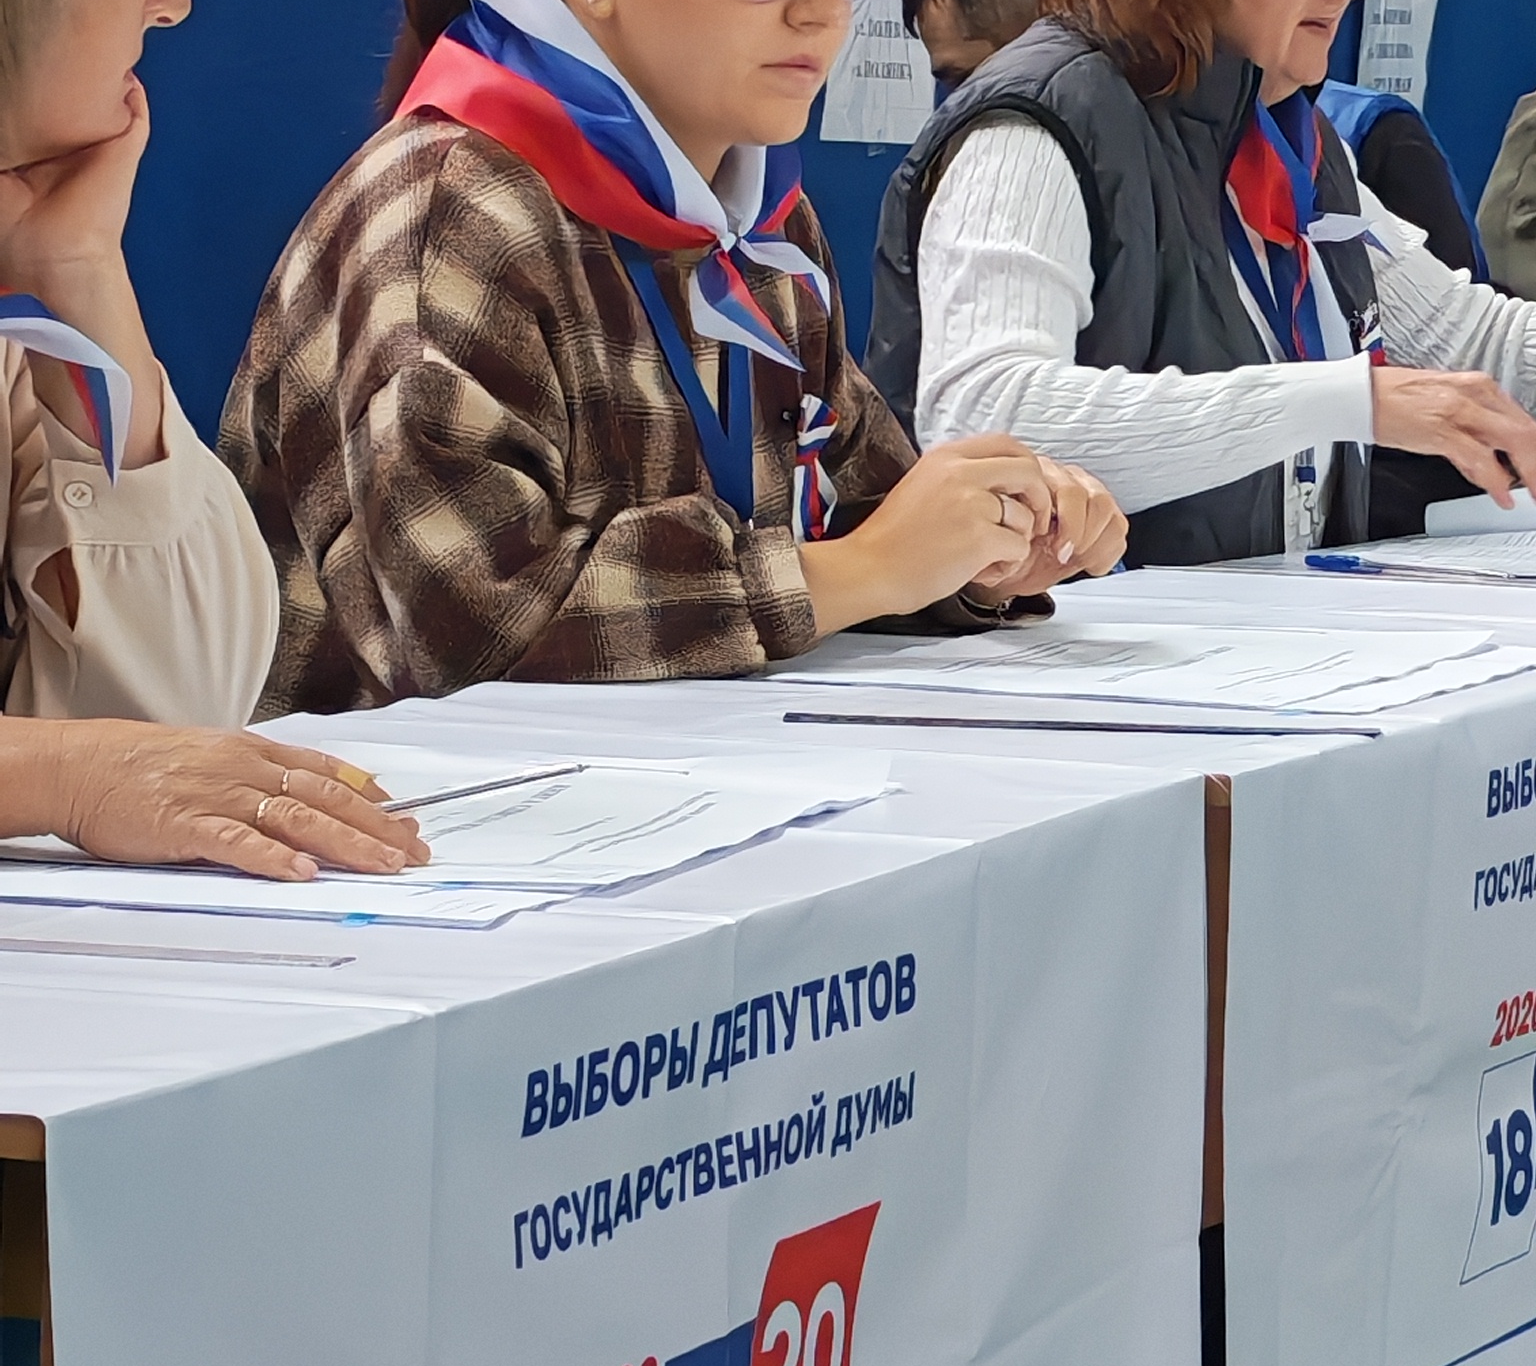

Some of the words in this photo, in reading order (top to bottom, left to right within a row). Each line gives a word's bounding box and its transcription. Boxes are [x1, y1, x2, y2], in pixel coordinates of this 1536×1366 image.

[521, 1022, 699, 1138] ВЫБОРЫ
[702, 953, 916, 1087] ДЕПУТАТОВ
[514, 1091, 825, 1269] ГОСУДАРСТВЕННОЙ
[830, 1071, 916, 1157] ДУМЫ
[1486, 1109, 1533, 1226] 18
